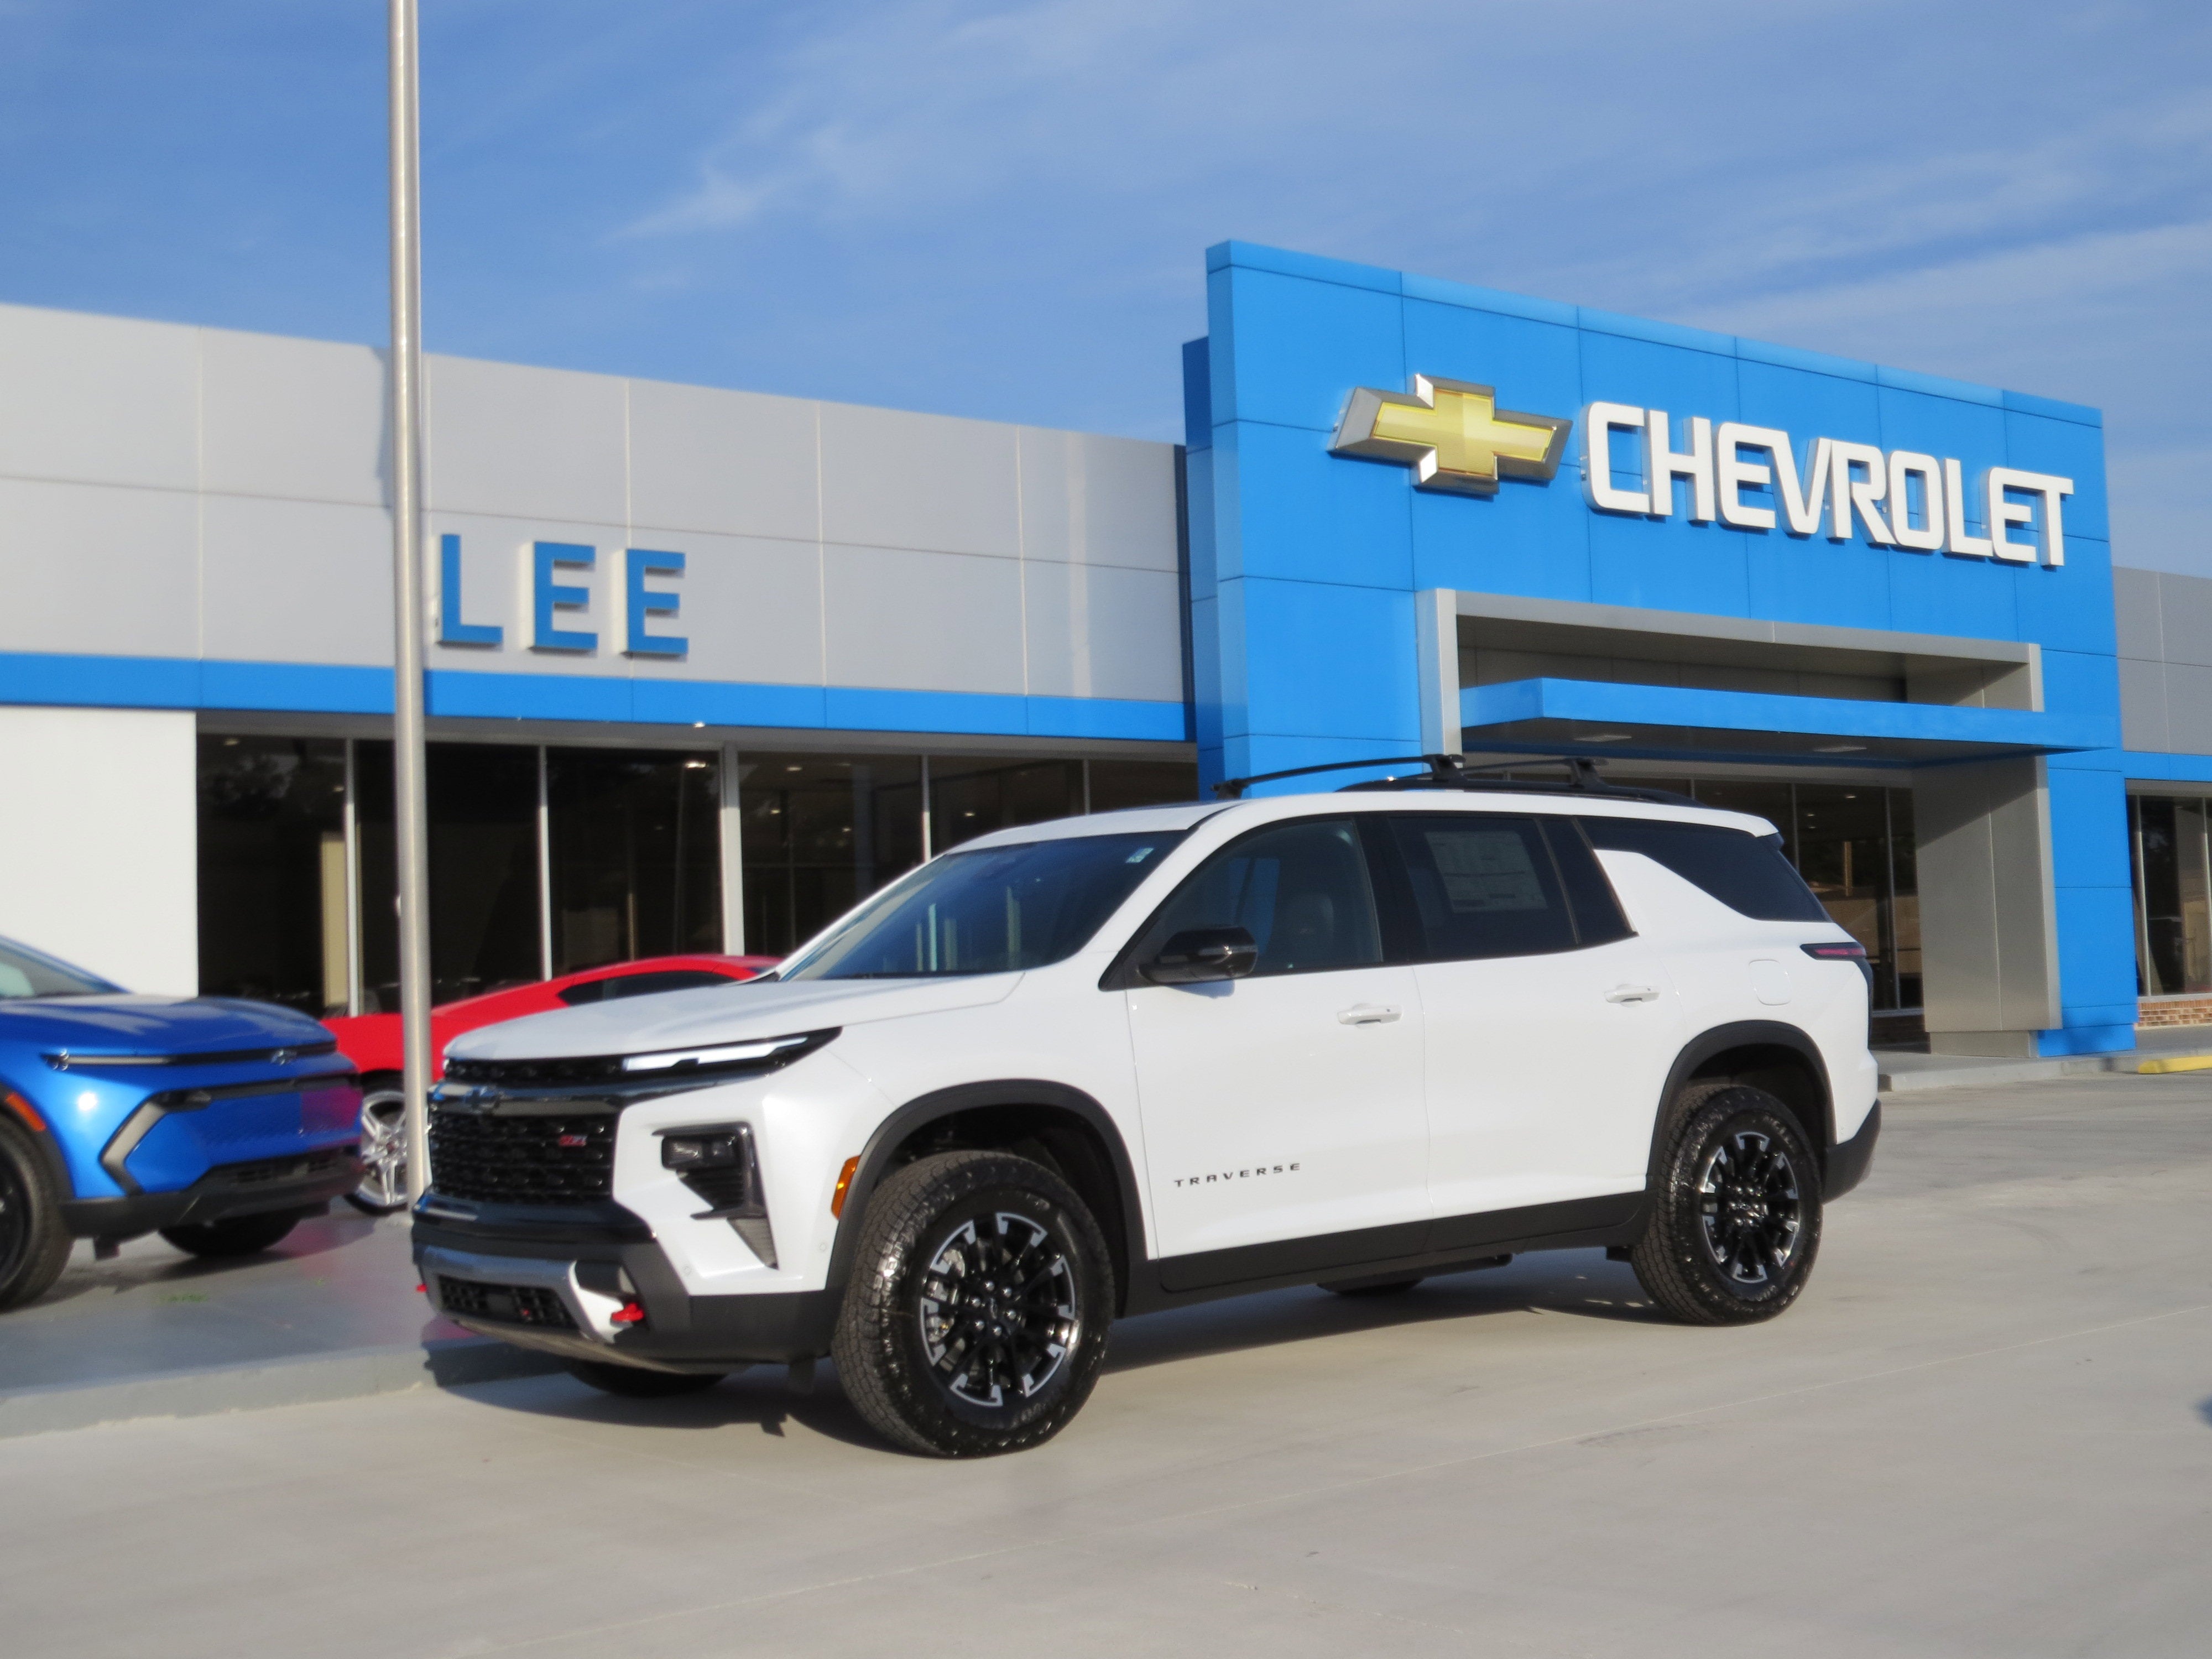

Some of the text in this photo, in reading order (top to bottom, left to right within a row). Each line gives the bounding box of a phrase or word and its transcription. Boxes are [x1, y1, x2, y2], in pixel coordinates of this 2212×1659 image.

[1585, 400, 2074, 567] CHEVROLET
[440, 533, 689, 655] LEE
[1173, 1162, 1301, 1188] TRAVERSE
